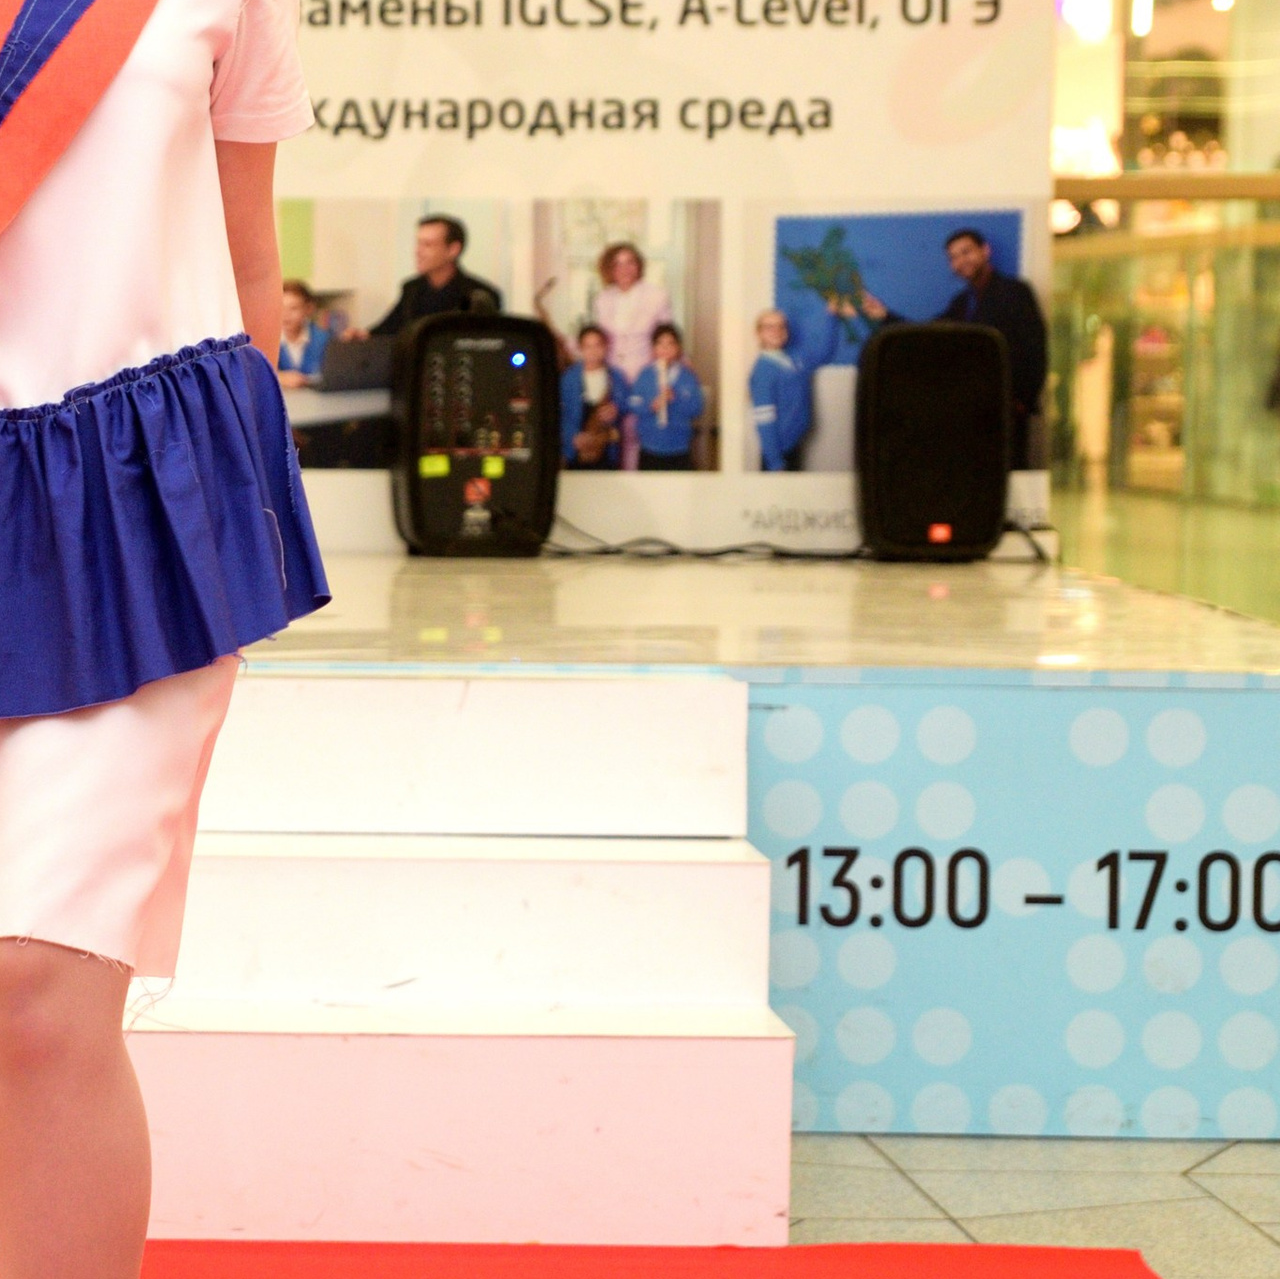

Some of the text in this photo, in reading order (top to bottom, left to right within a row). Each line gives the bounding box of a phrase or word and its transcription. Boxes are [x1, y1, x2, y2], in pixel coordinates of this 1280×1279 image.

[678, 98, 832, 140] среда
[787, 846, 990, 929] 13:00
[1096, 850, 1280, 933] 17:00
